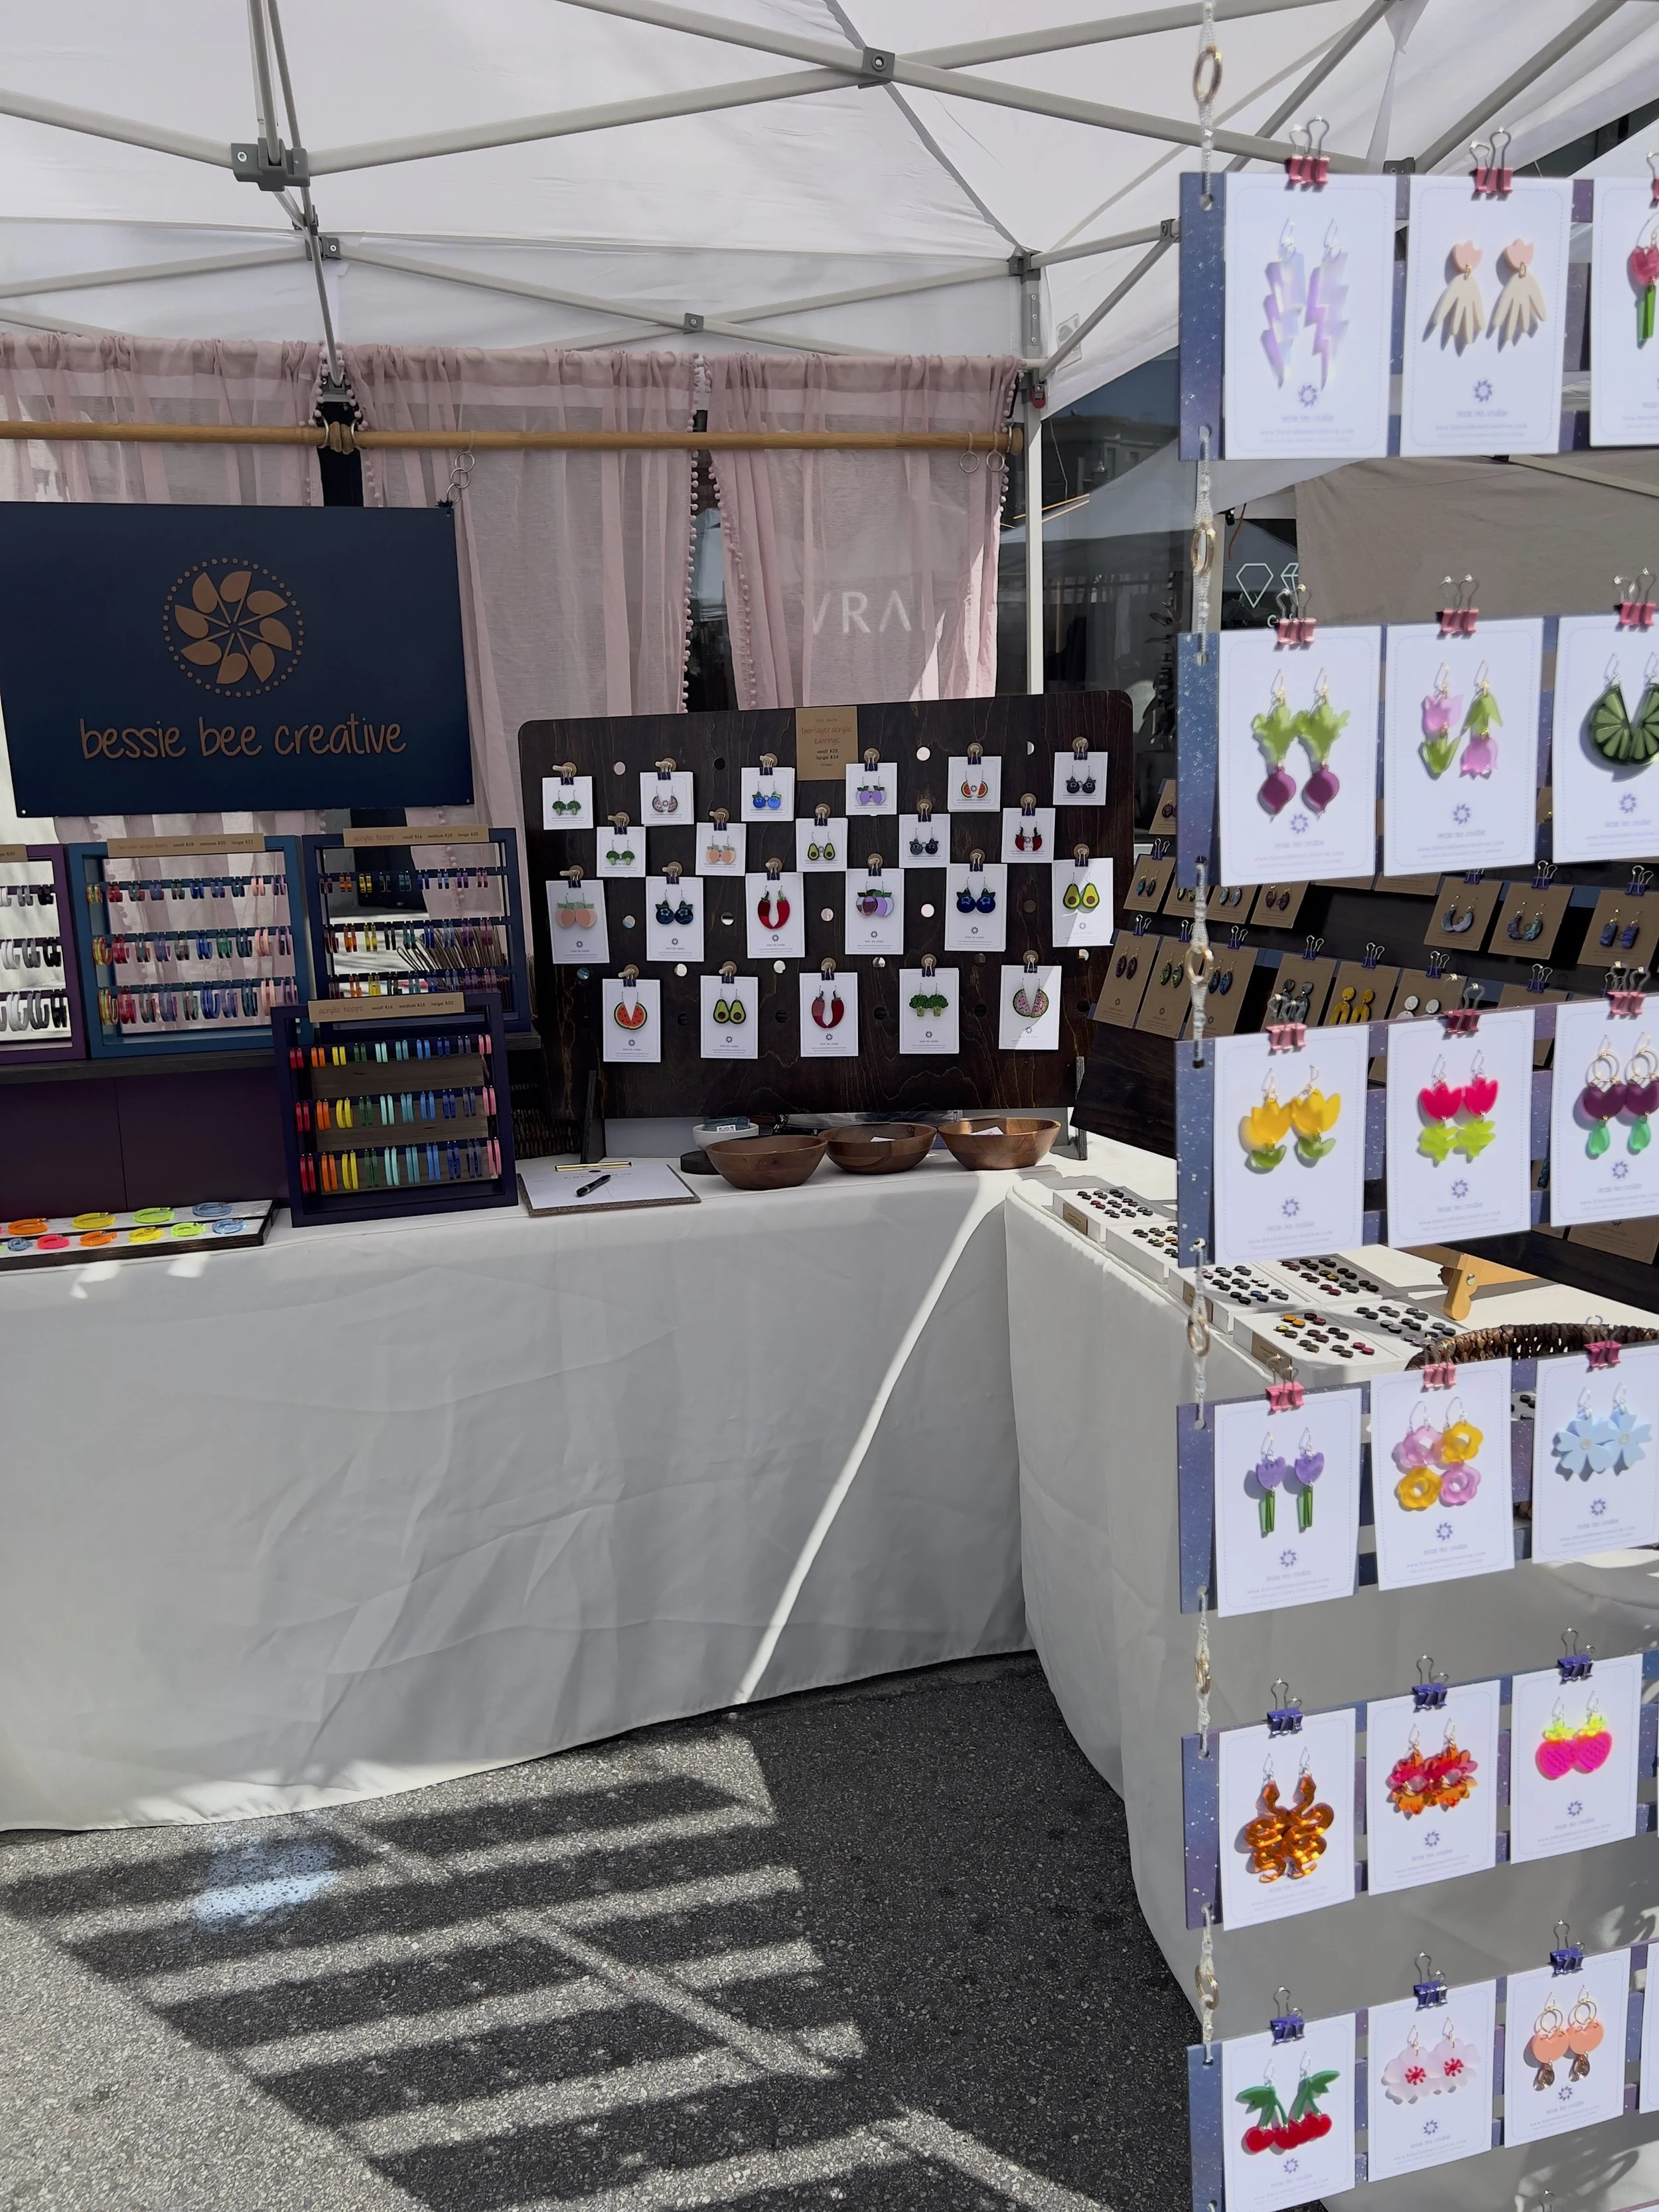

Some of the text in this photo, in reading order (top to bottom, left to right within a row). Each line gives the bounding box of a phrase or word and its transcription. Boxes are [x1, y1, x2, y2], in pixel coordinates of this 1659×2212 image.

[80, 713, 407, 759] bessie bee creative
[353, 834, 374, 843] acrylic
[319, 1006, 341, 1015] acrylic
[343, 1005, 363, 1013] hoops
